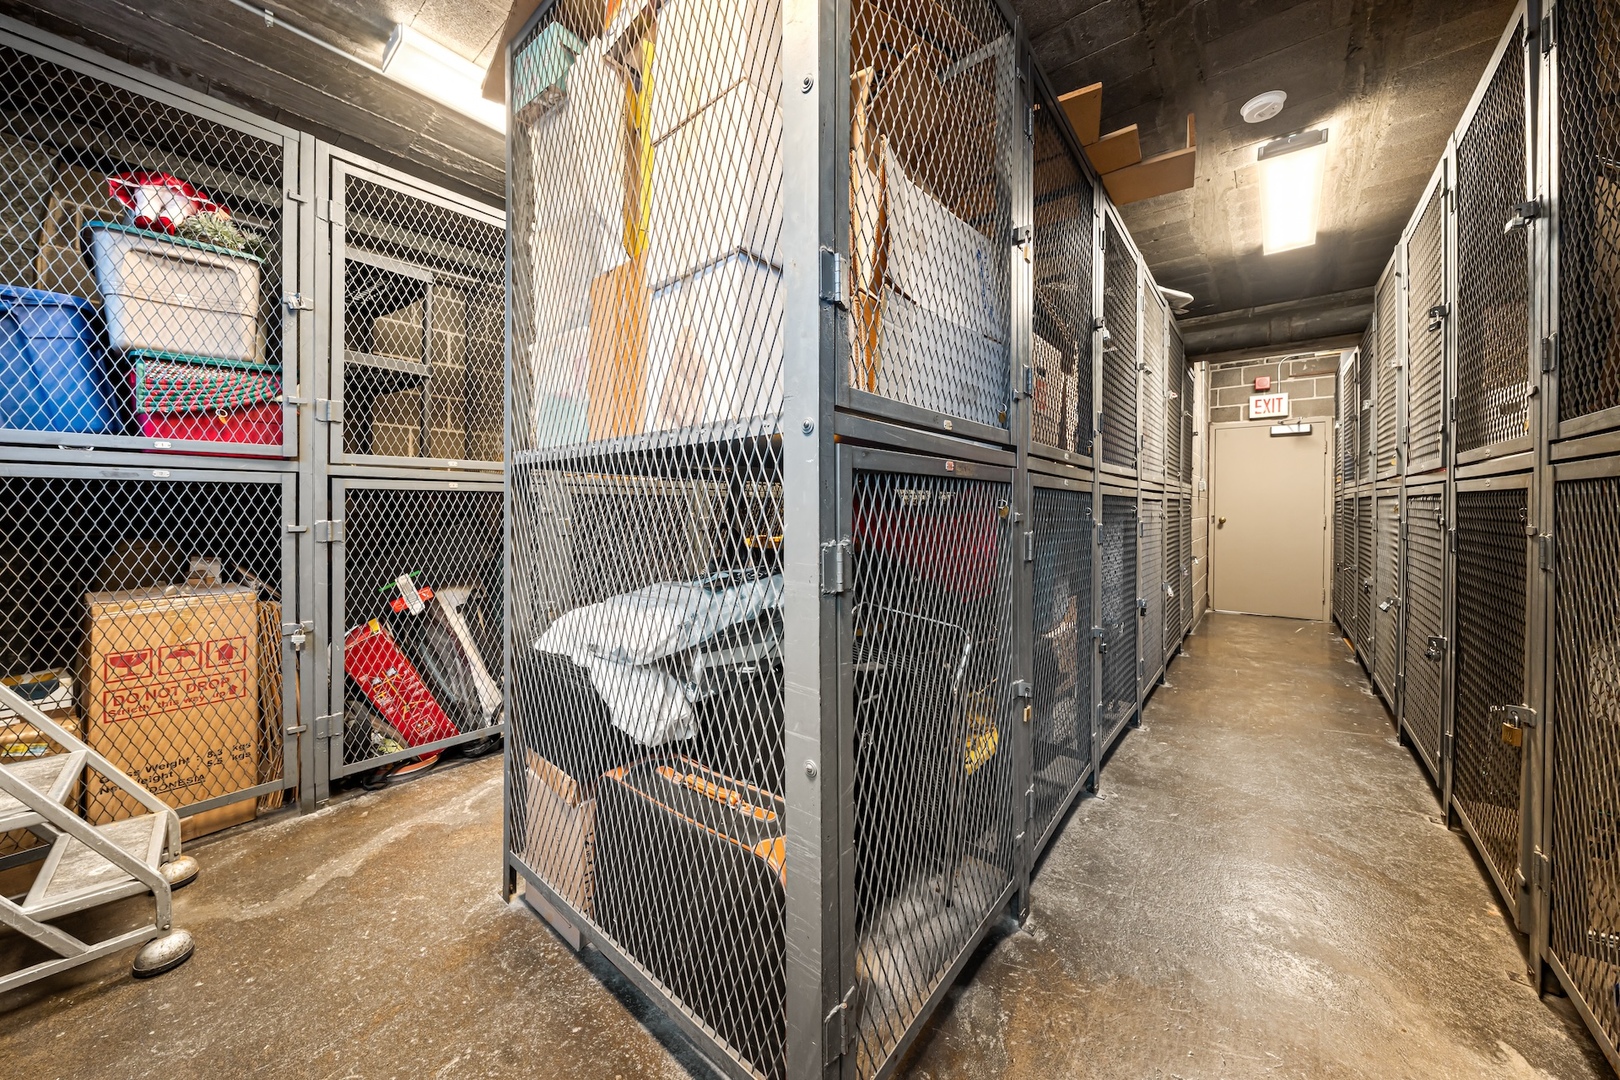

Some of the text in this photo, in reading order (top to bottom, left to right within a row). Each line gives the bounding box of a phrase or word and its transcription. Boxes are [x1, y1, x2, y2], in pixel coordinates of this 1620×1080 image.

[1255, 397, 1283, 414] EXIT
[112, 677, 231, 707] DO NOT DROP
[157, 700, 180, 709] this
[183, 694, 206, 705] way
[212, 691, 226, 699] up
